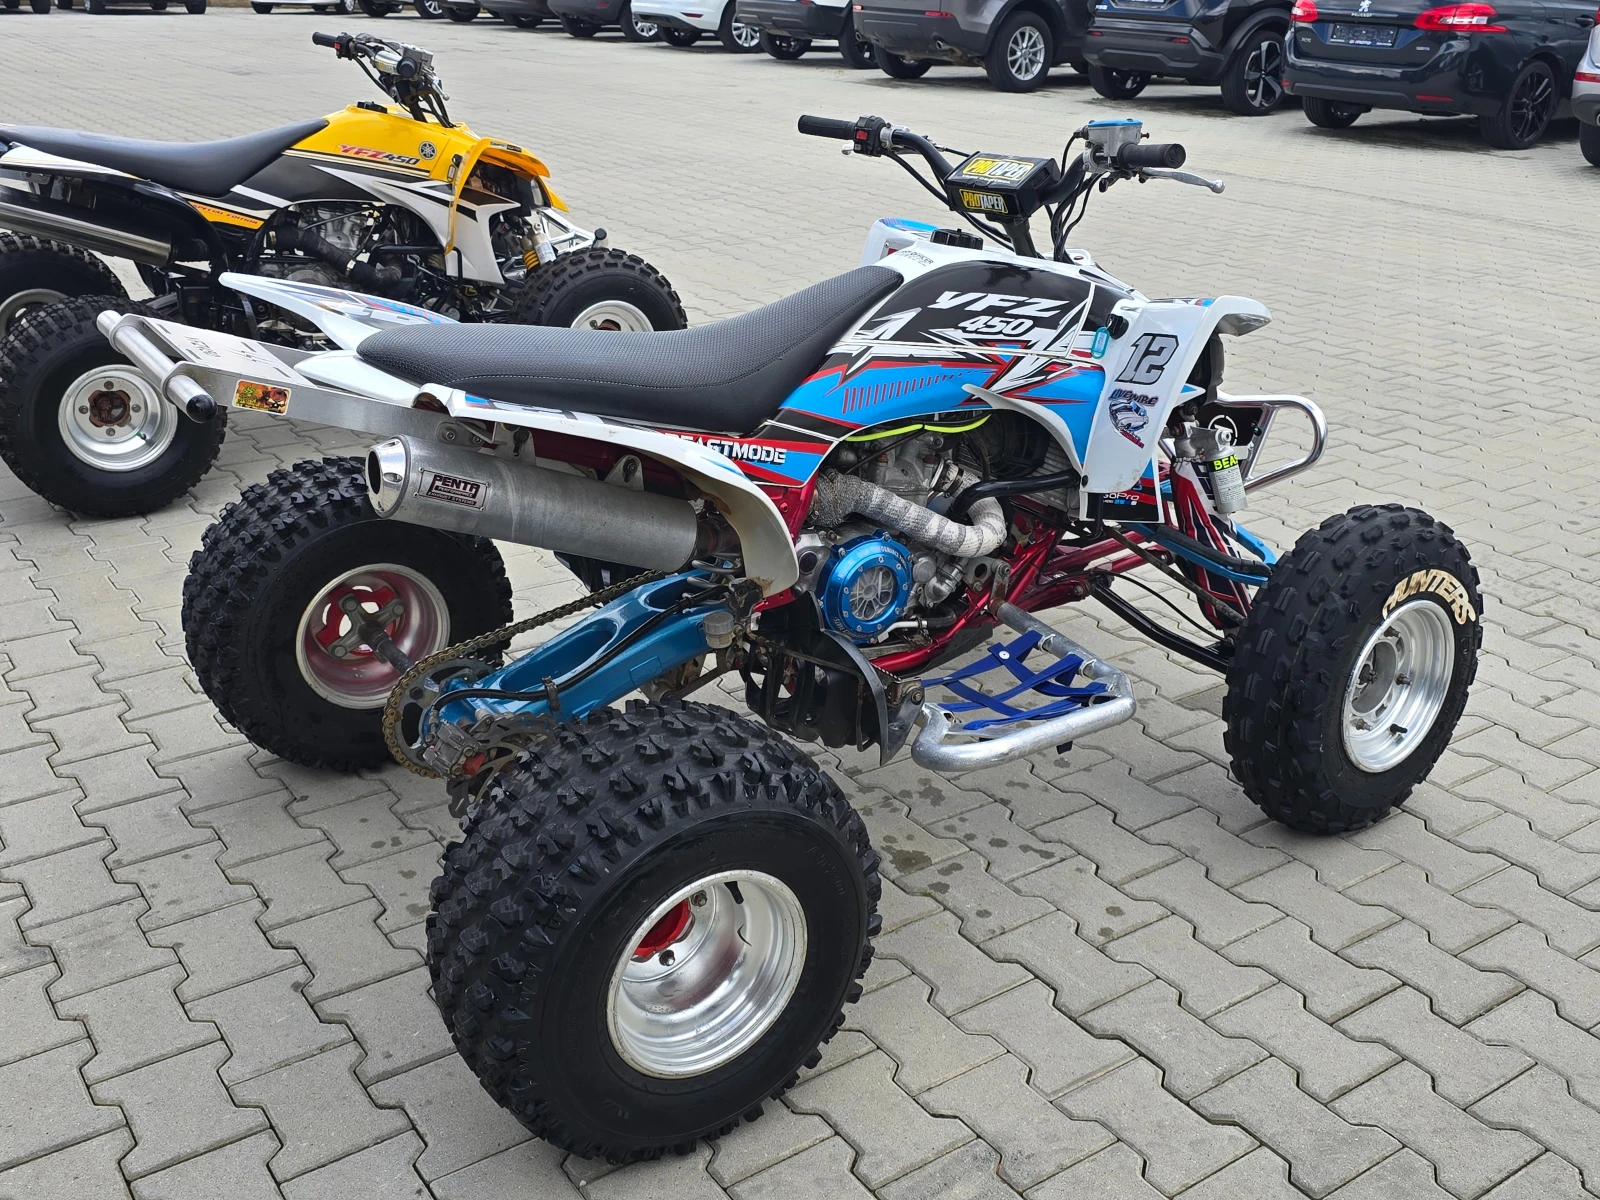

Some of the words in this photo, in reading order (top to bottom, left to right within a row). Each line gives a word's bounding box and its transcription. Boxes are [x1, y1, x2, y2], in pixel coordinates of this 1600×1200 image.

[963, 191, 1006, 212] PROTAPER
[193, 203, 224, 215] SPECIAL
[226, 213, 259, 225] EDITION
[927, 291, 1070, 318] YFZ
[957, 315, 1034, 335] 450
[1115, 332, 1180, 385] 12
[664, 432, 788, 464] STMODE
[428, 474, 480, 496] PENTA
